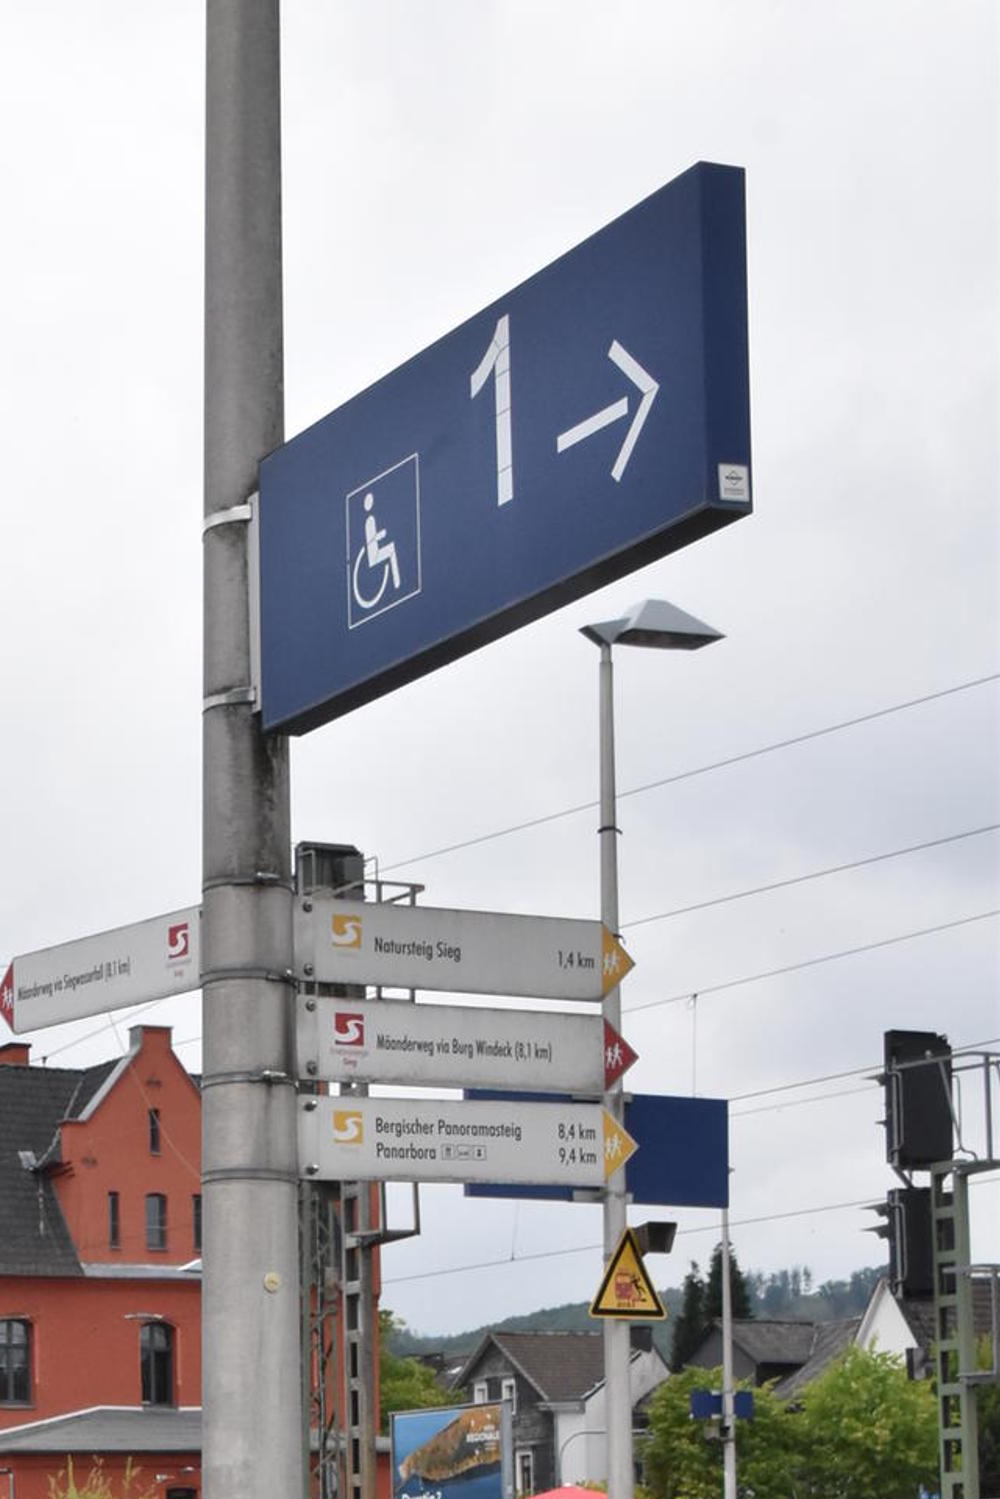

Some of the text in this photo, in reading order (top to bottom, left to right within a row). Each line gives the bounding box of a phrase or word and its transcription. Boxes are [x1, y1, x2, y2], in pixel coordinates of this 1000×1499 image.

[470, 313, 514, 507] 1
[374, 936, 462, 963] Natursteig Sieg
[558, 950, 595, 969] 1,4 km
[376, 1034, 434, 1057] Mäanderweg
[435, 1040, 450, 1054] via
[451, 1038, 474, 1060] Burg
[475, 1040, 513, 1058] Windeck
[533, 1043, 552, 1063] km)
[375, 1116, 522, 1141] Bergischer Panoramasteig
[558, 1122, 596, 1142] 8,4 km
[375, 1142, 437, 1161] Panarbora
[558, 1147, 597, 1167] 9,4 km
